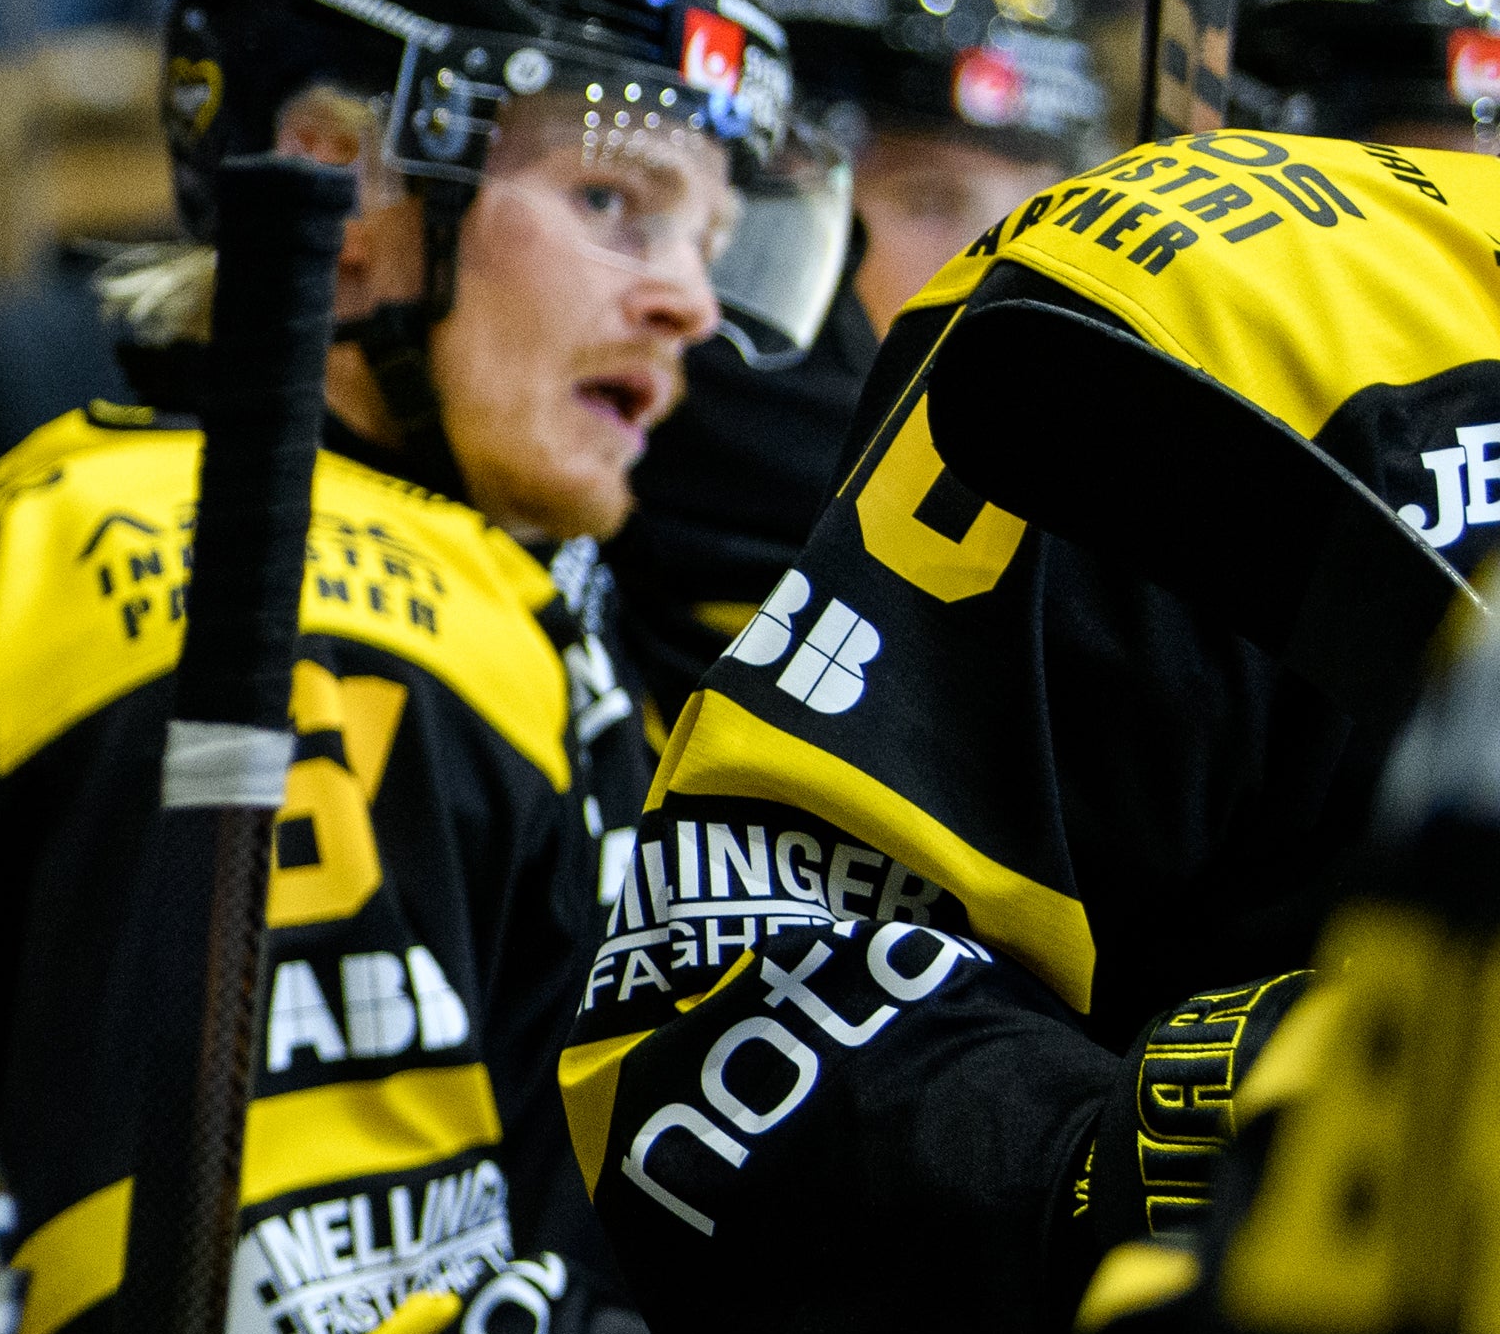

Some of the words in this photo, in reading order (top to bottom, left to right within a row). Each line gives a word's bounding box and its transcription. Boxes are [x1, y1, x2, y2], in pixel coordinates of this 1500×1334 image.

[964, 183, 1200, 278] ARTNER
[726, 567, 882, 714] BB
[622, 920, 992, 1237] nota
